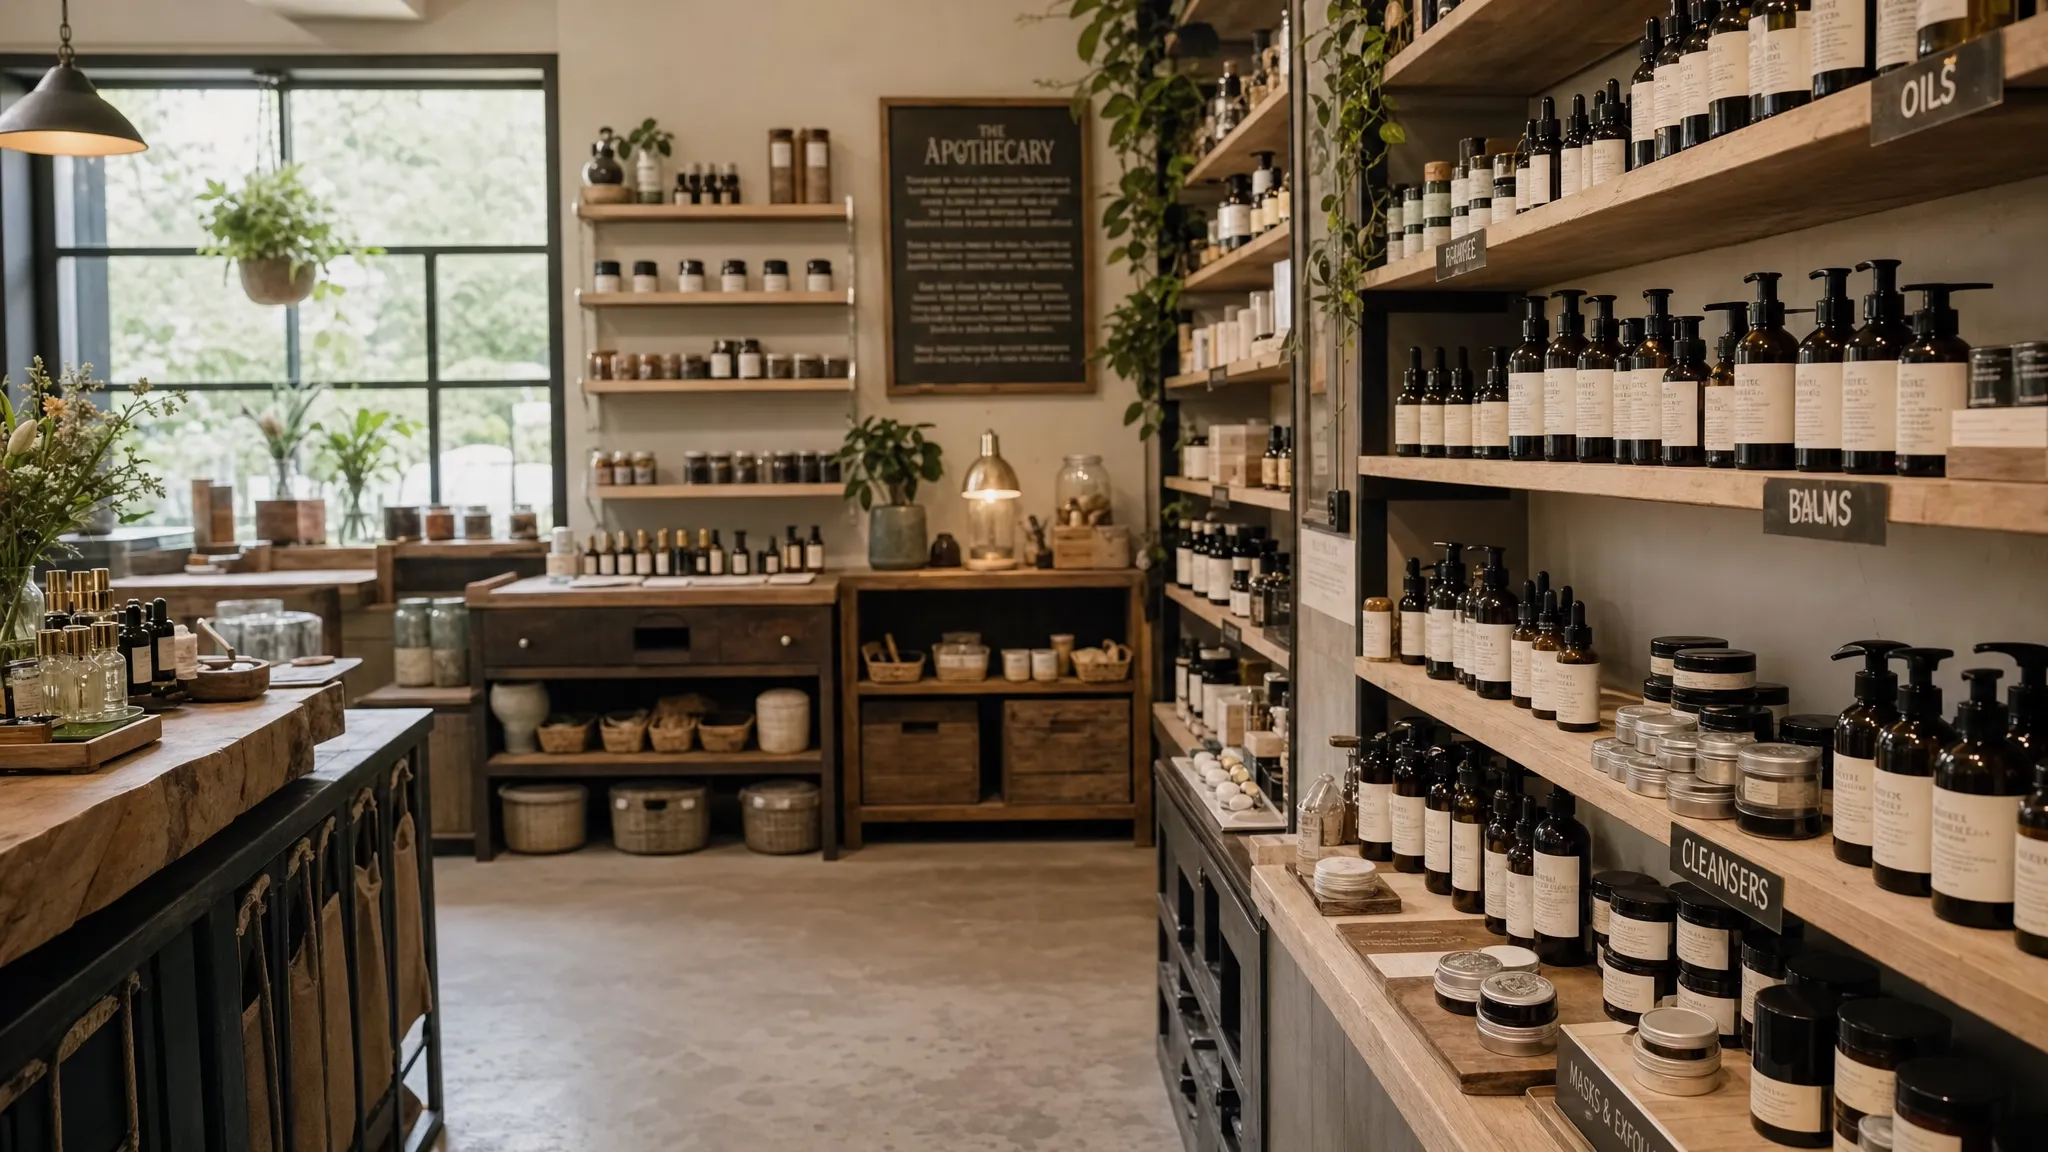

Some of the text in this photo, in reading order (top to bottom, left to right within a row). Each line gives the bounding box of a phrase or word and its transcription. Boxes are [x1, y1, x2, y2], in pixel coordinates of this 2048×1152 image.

[1901, 63, 1956, 118] OILS
[924, 137, 1055, 165] APOTHECARY
[978, 124, 1005, 137] THE
[1789, 488, 1852, 527] BALMS
[1682, 838, 1769, 911] CLEANSERS
[1569, 1061, 1601, 1114] MASKS
[1602, 1098, 1611, 1127] &
